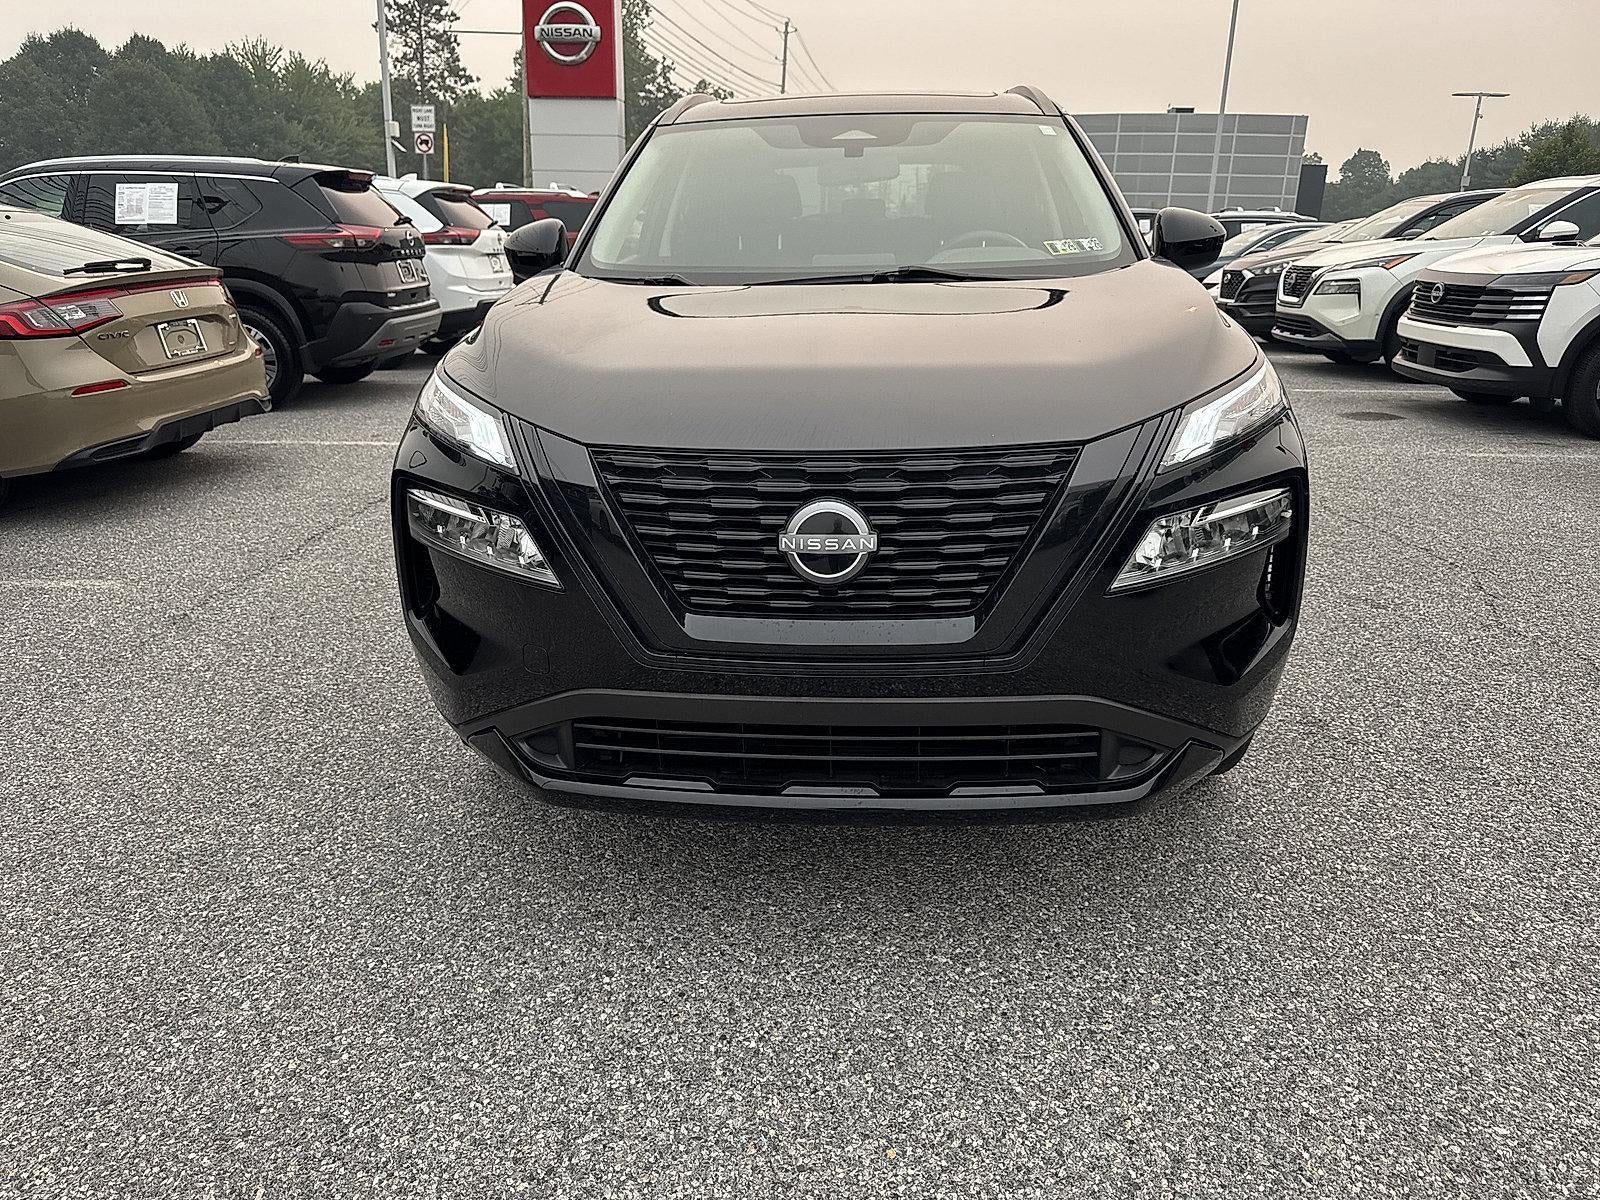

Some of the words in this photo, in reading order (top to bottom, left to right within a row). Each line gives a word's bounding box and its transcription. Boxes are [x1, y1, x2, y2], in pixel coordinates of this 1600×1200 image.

[540, 27, 593, 38] NISSAN
[97, 330, 130, 341] CIVIC
[781, 537, 875, 551] NISSAN
